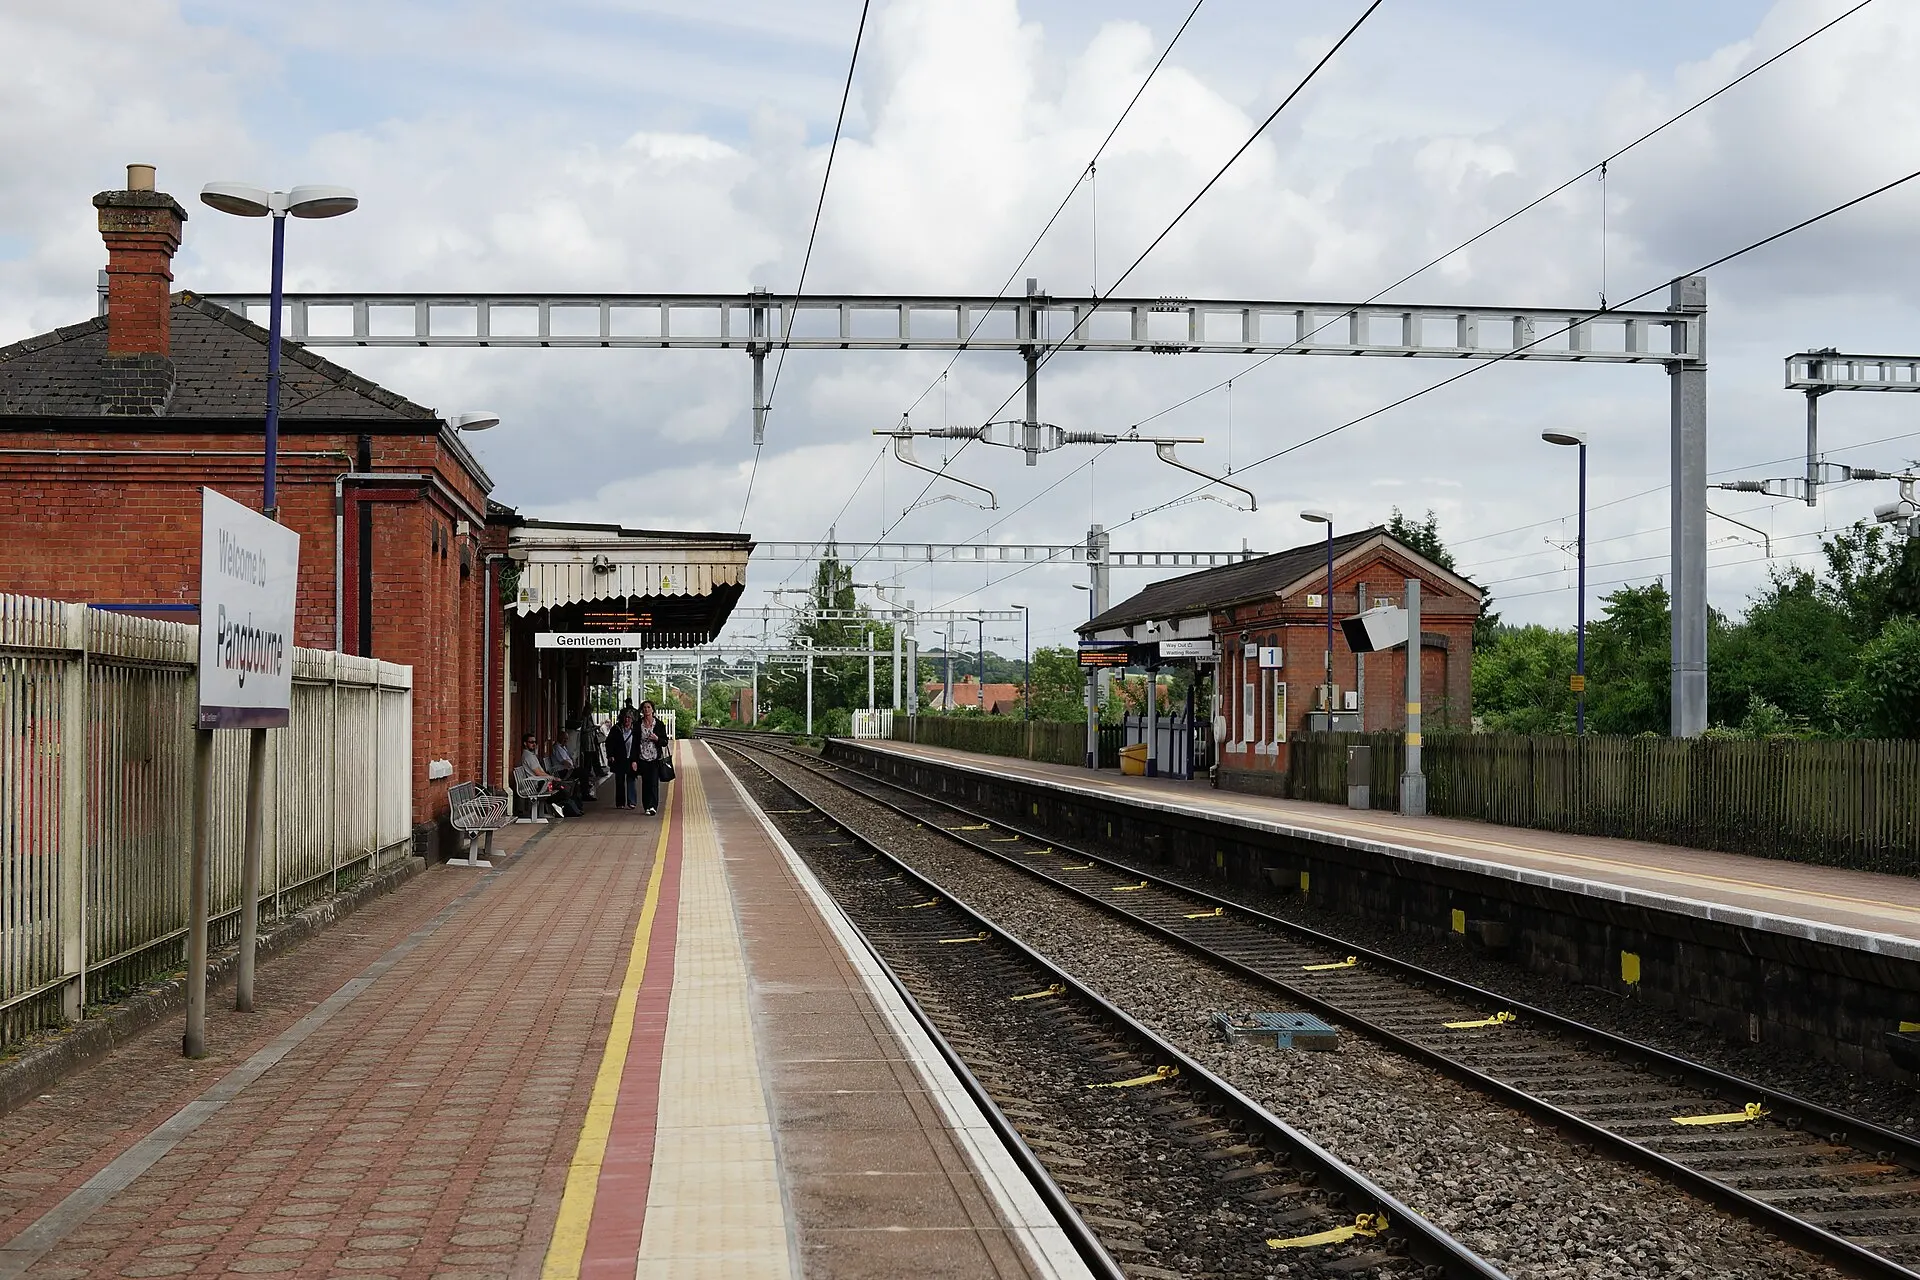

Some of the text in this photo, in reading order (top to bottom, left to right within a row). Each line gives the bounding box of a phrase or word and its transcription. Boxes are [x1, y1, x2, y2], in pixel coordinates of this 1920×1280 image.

[219, 528, 267, 588] Welcome to
[217, 603, 283, 688] Pangbourne
[556, 635, 622, 646] Gentlemen
[1268, 649, 1274, 665] 1
